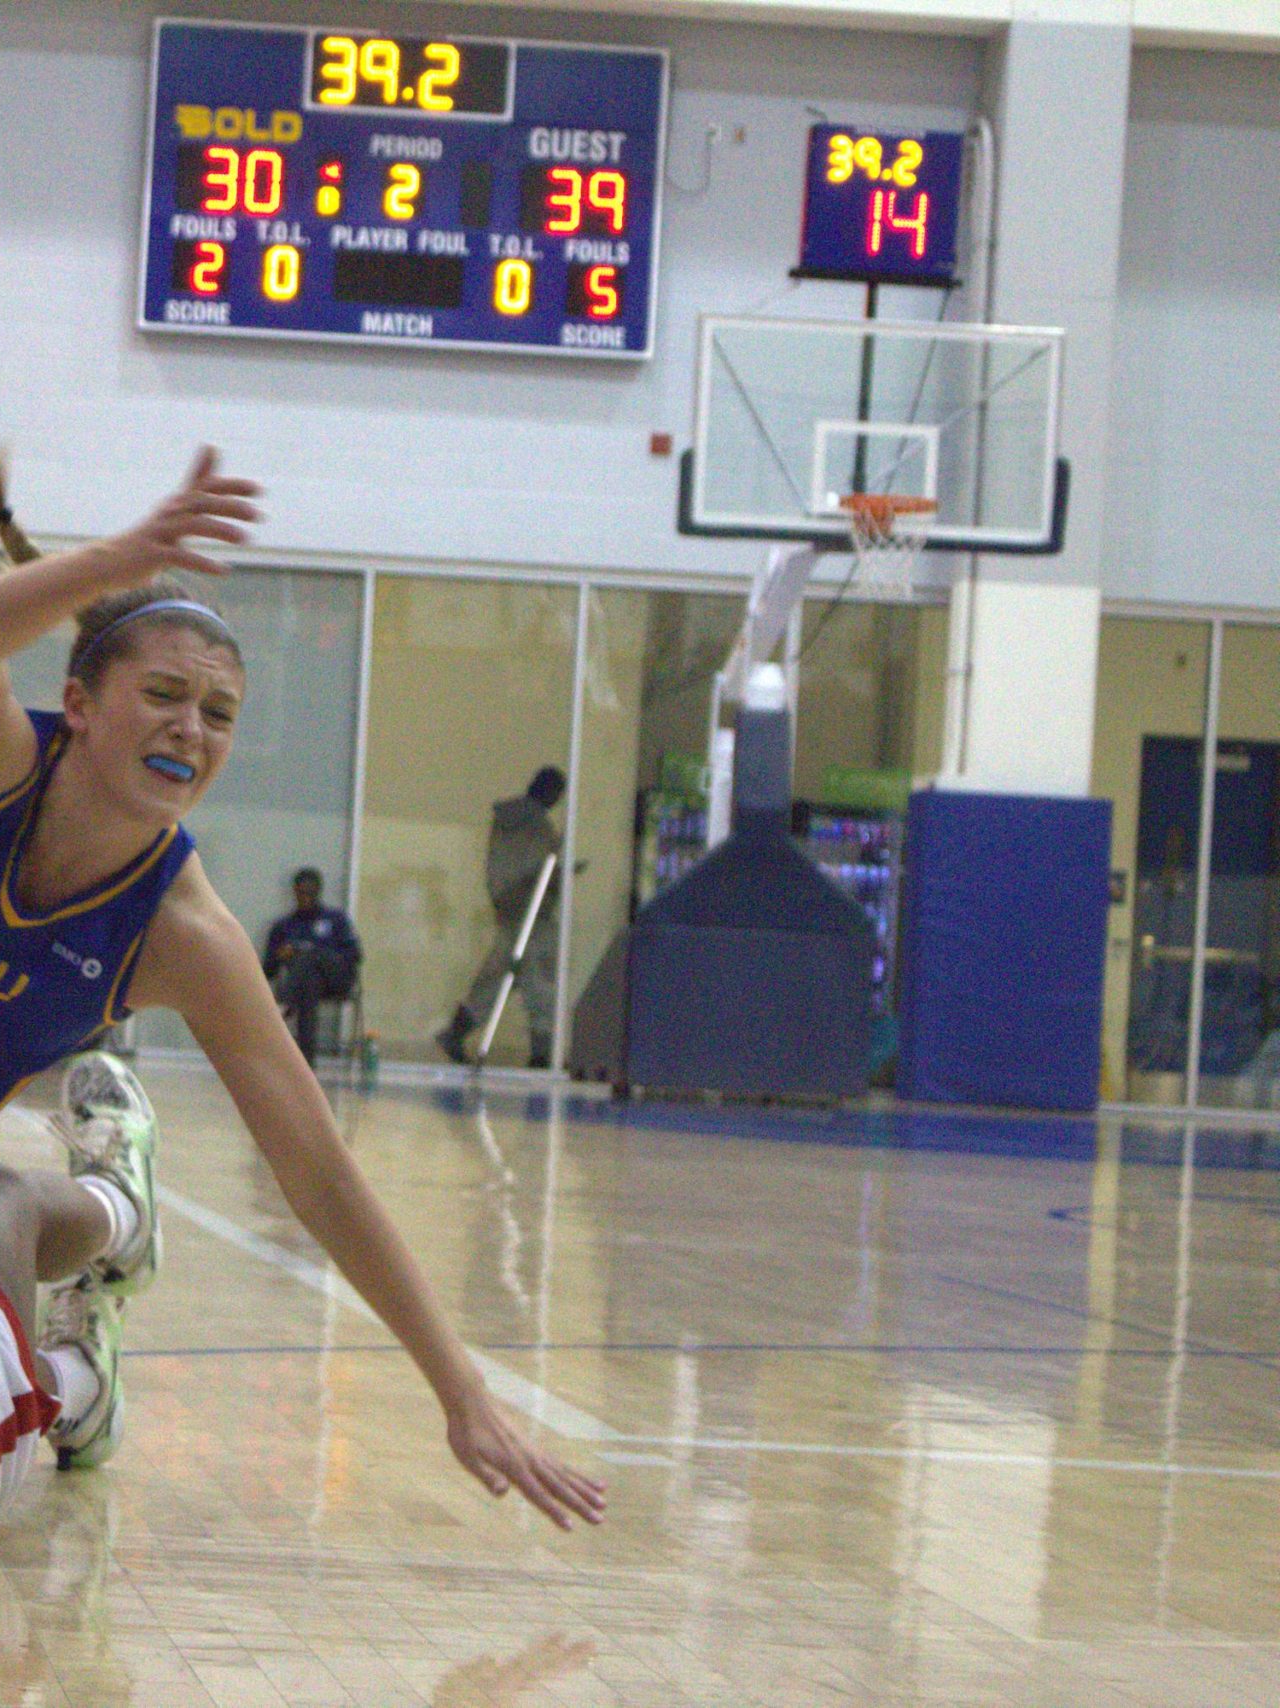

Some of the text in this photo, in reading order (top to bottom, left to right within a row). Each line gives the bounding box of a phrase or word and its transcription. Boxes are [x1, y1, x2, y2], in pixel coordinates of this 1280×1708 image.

[320, 37, 460, 111] 39.2
[369, 134, 443, 159] PERIOD
[529, 126, 626, 163] GUEST
[826, 134, 923, 187] 39.2
[202, 145, 283, 216] 30
[384, 163, 420, 219] 2
[546, 166, 626, 235] 39
[170, 214, 237, 241] FOULS
[330, 224, 470, 256] PLAYER FOUL
[868, 189, 929, 258] 14
[190, 241, 225, 295] 2
[262, 243, 300, 301] 0
[565, 238, 630, 266] FOULS
[164, 299, 232, 325] SCORE
[494, 258, 532, 315] 0
[586, 265, 618, 321] 5
[360, 310, 433, 337] MATCH
[560, 322, 627, 348] SCORE
